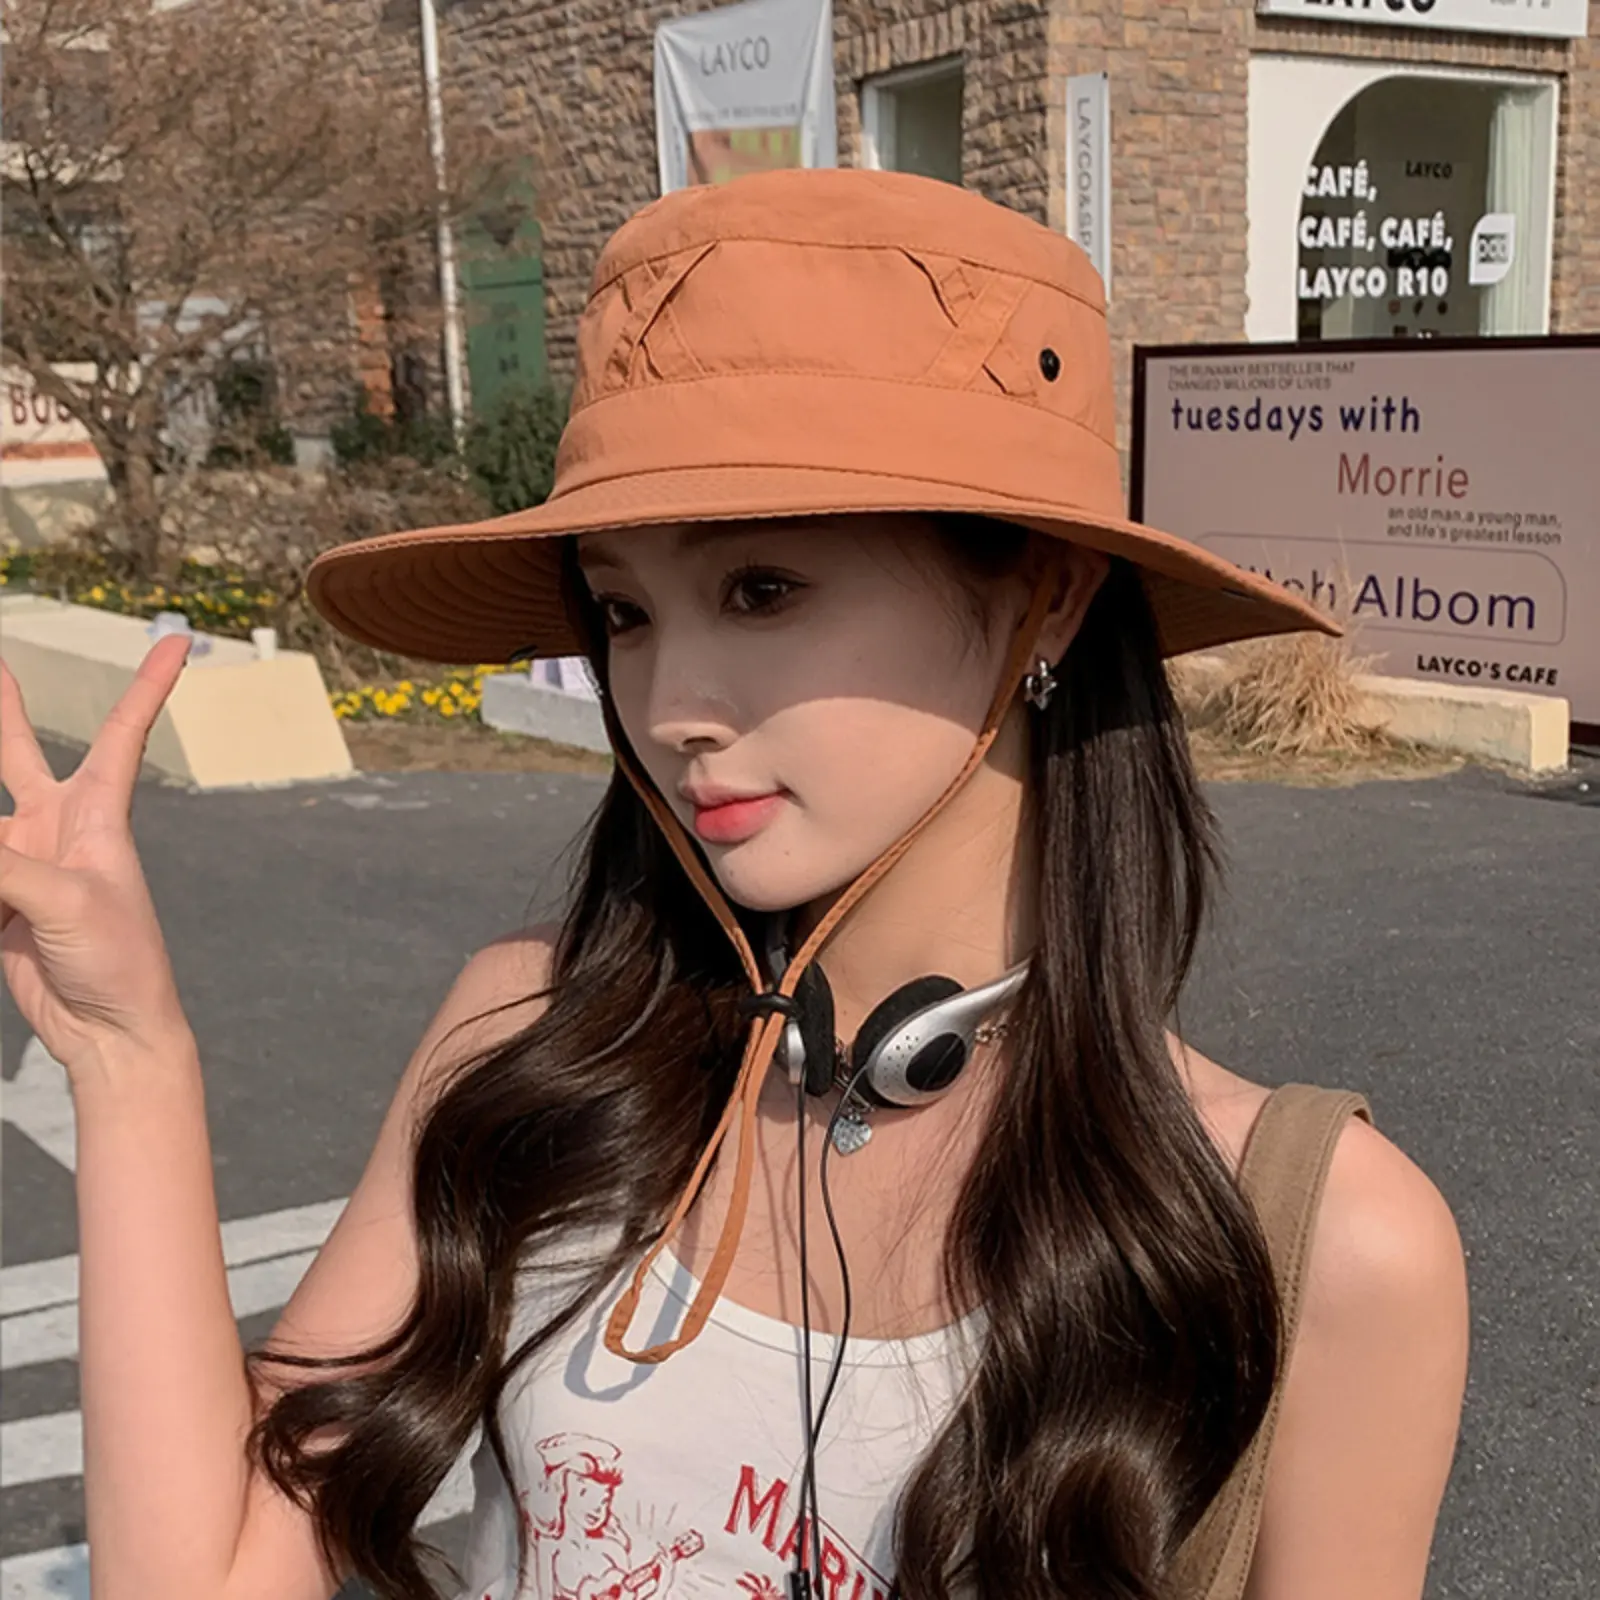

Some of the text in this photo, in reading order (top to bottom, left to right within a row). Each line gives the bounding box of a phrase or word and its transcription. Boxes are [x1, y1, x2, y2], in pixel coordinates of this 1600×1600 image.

[701, 36, 770, 76] LAYCO
[1303, 159, 1377, 202] CAFÉ,
[1405, 160, 1452, 179] LAYCO
[1300, 209, 1375, 252] CAFÉ,
[1380, 210, 1453, 253] CAFÉ,
[1299, 266, 1448, 298] LAYCO R10
[1247, 362, 1323, 374] BESTSELLER
[1326, 361, 1355, 373] THAT
[1167, 377, 1331, 391] CHANGED MILLIONS OF LIVES
[1171, 396, 1420, 440] tuesdays with
[1337, 453, 1469, 499] Morrie
[1387, 507, 1404, 520] an
[1407, 506, 1429, 520] old
[1478, 511, 1521, 527] young
[1387, 523, 1412, 537] and
[1450, 526, 1508, 543] greatest
[1512, 527, 1562, 545] lesson
[1352, 573, 1536, 630] Albom
[1416, 654, 1558, 686] LAYCO'S CAFE
